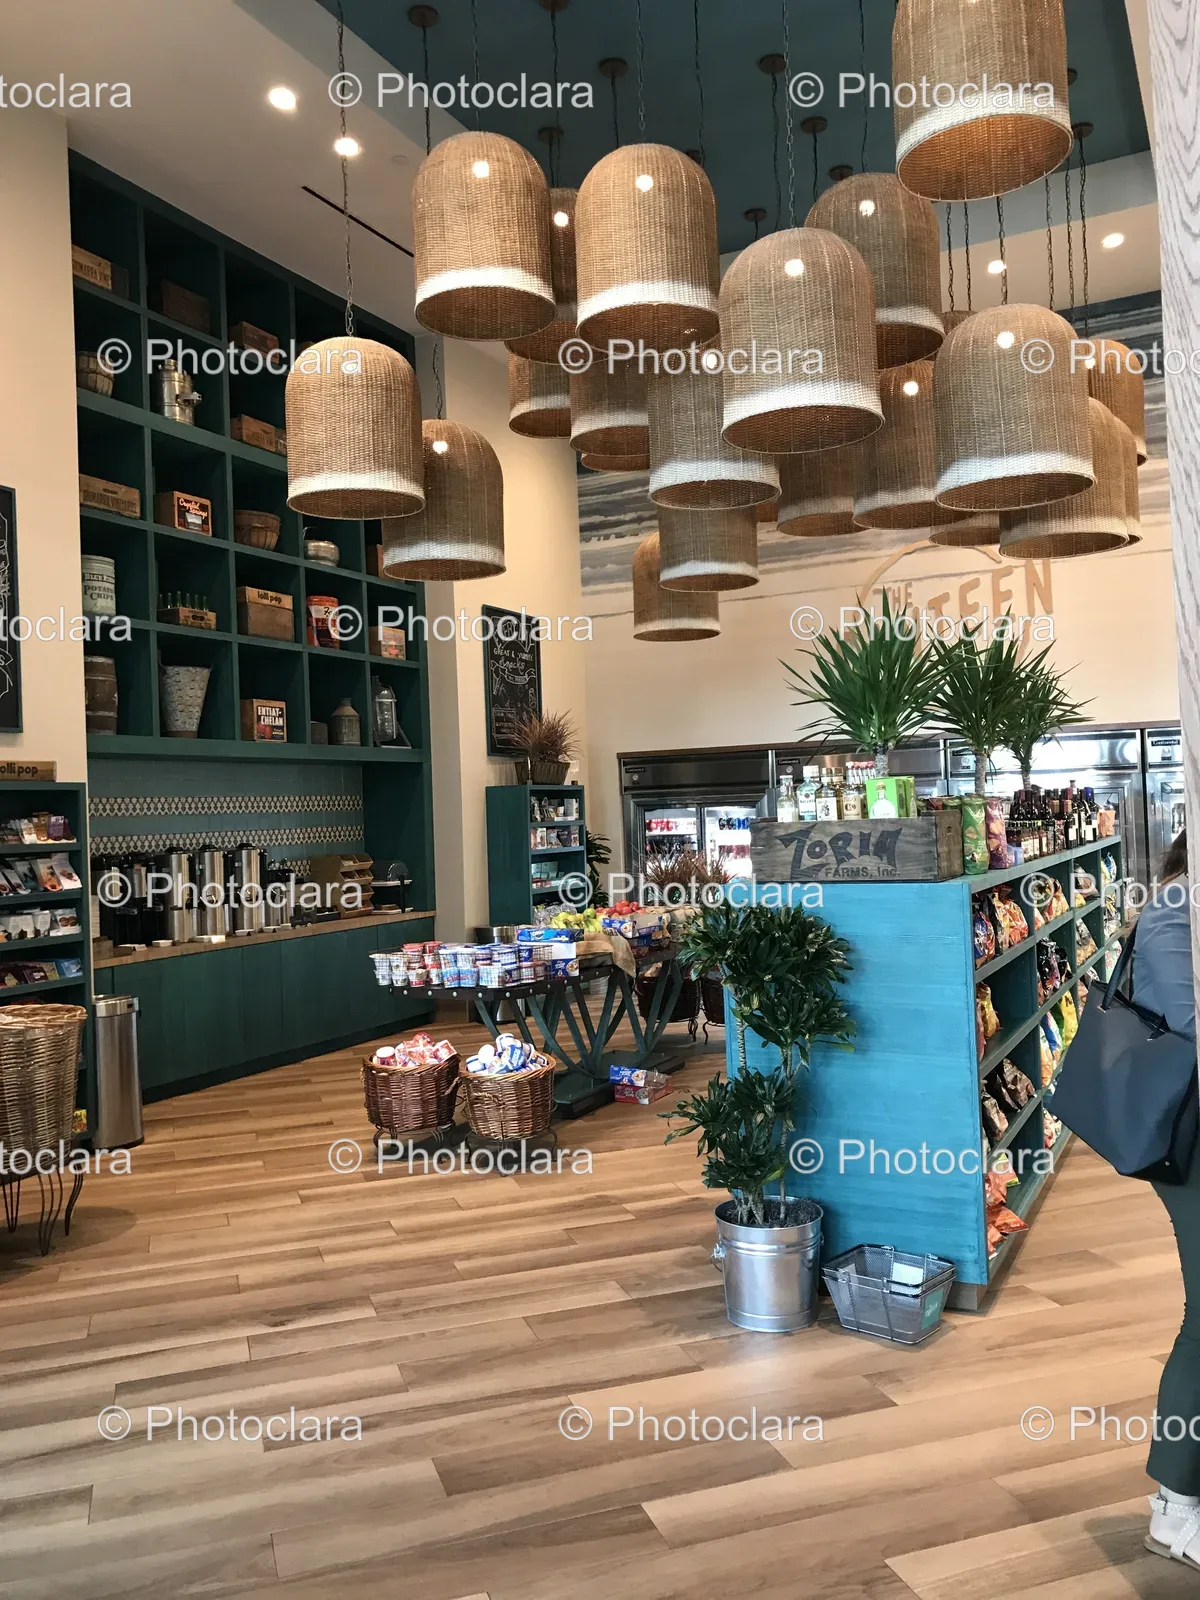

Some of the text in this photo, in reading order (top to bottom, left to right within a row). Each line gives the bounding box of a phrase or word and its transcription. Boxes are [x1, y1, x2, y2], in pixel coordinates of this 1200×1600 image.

[90, 592, 114, 601] CHIPS
[873, 582, 913, 613] THE
[260, 715, 284, 726] CHELAN
[17, 765, 39, 778] pop
[825, 866, 901, 879] FARMS, Inc.
